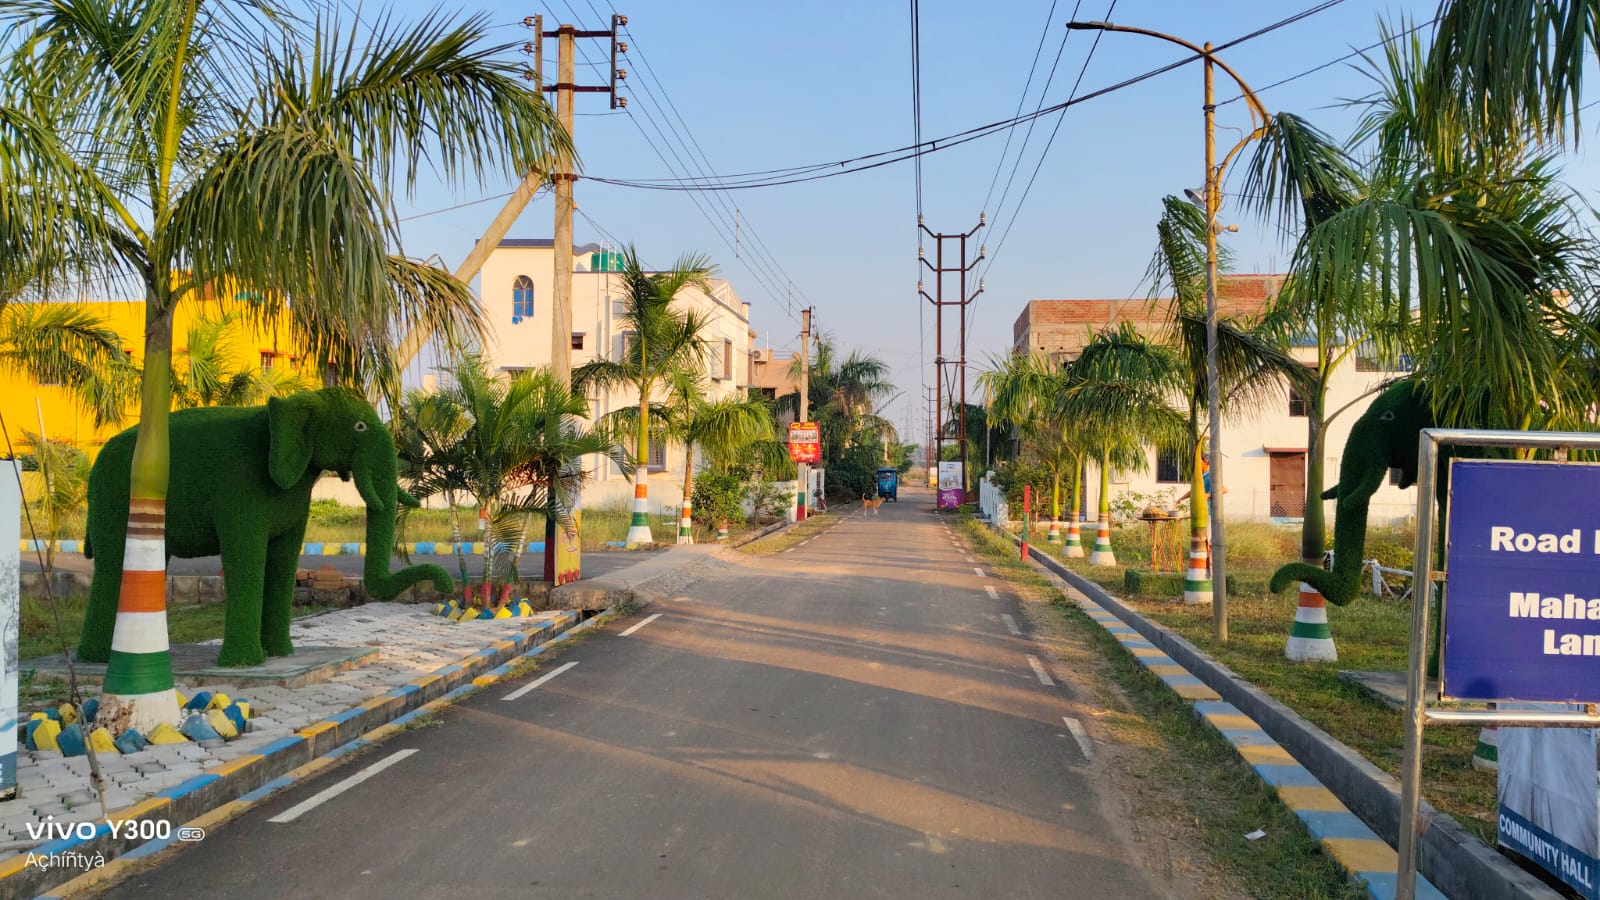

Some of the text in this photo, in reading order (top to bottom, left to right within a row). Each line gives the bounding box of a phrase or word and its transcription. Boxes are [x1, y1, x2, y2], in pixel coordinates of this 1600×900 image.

[1490, 526, 1581, 554] Road
[1500, 814, 1592, 889] COMMUNITY HALL
